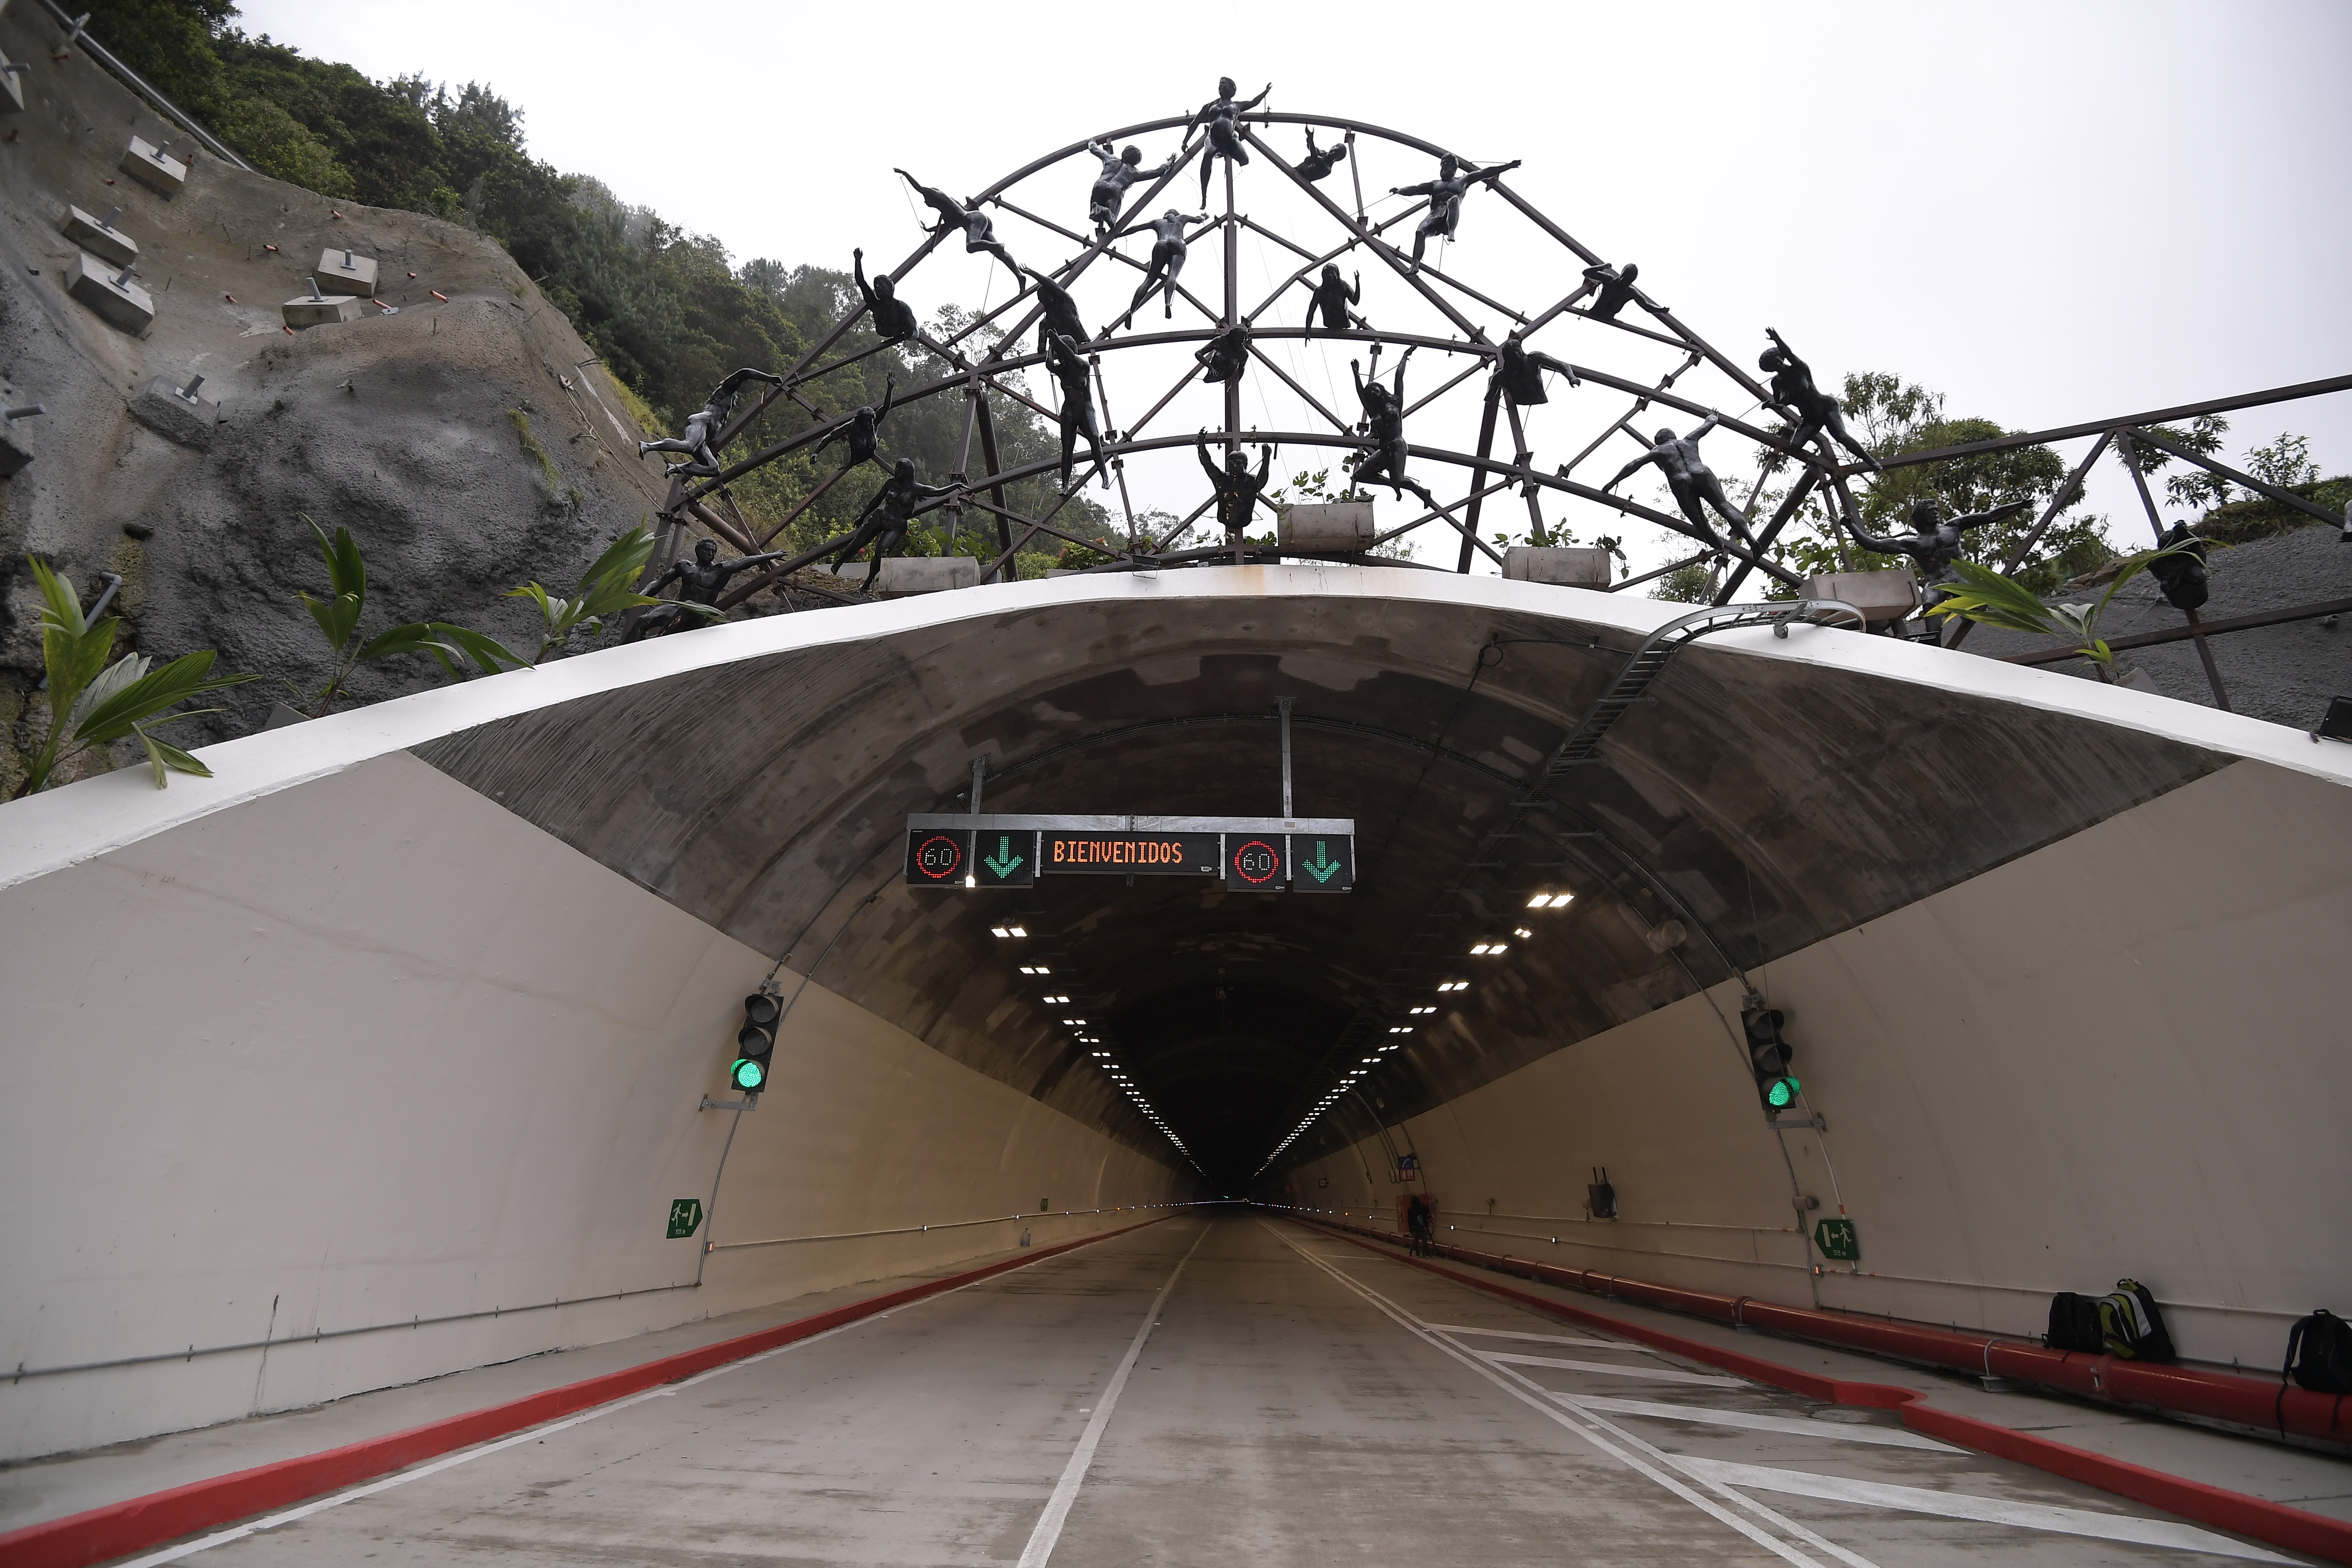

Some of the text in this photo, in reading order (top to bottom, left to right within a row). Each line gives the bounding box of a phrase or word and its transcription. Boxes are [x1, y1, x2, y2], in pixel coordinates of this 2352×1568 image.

[924, 848, 953, 866] 60
[1054, 841, 1182, 863] BIENVENIDOS
[1243, 853, 1270, 871] 60
